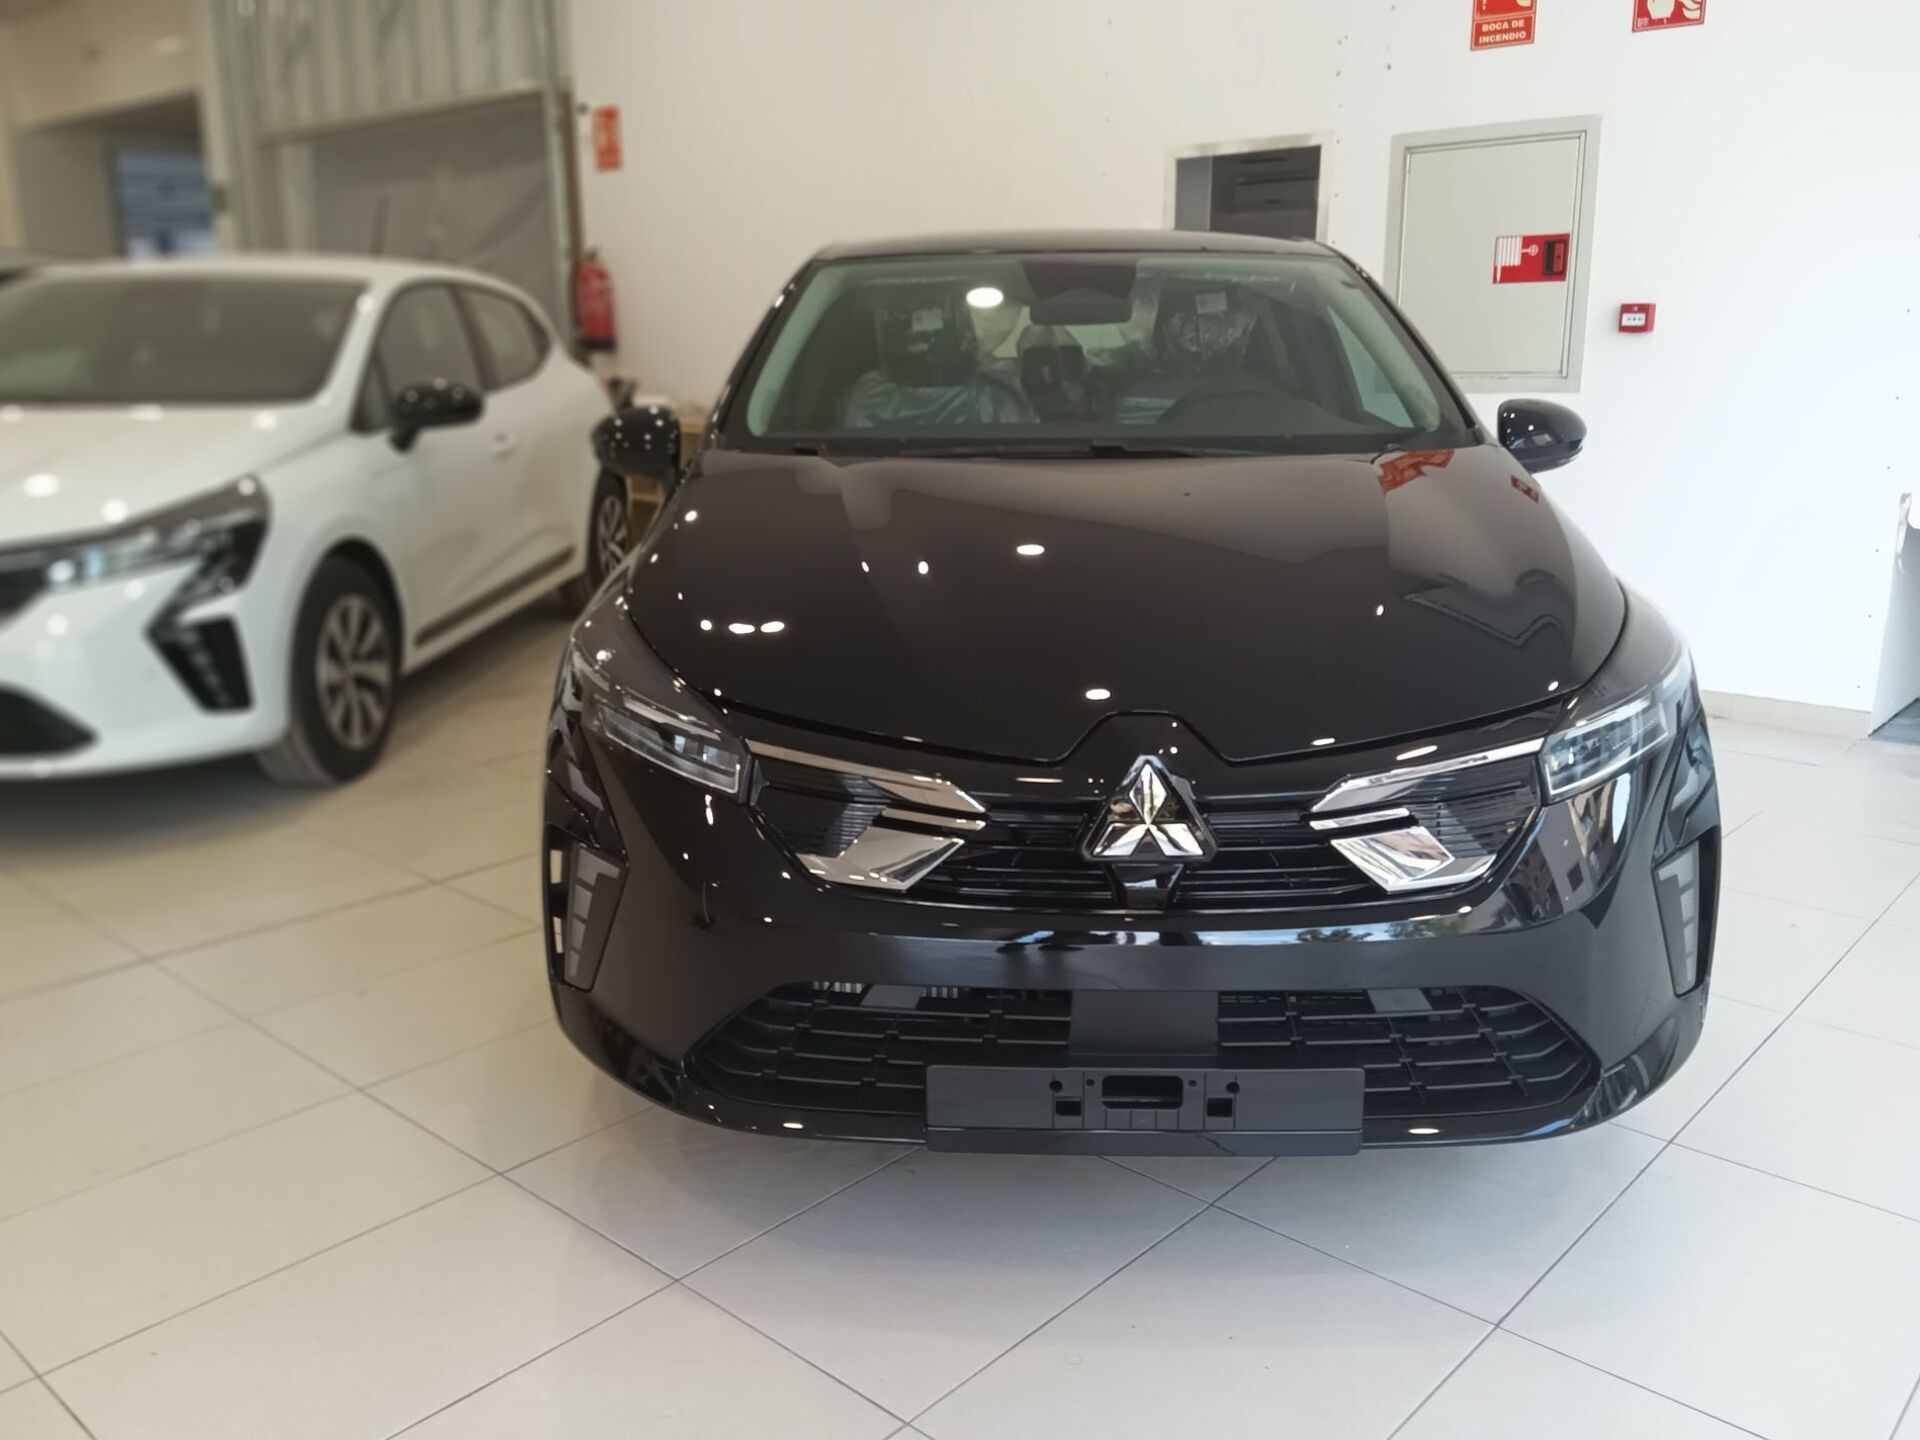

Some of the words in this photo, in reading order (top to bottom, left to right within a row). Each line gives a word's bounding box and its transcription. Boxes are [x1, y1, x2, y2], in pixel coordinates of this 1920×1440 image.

[1482, 21, 1509, 32] BOCA
[1511, 19, 1525, 28] DE
[1479, 31, 1526, 44] INCENDIO
